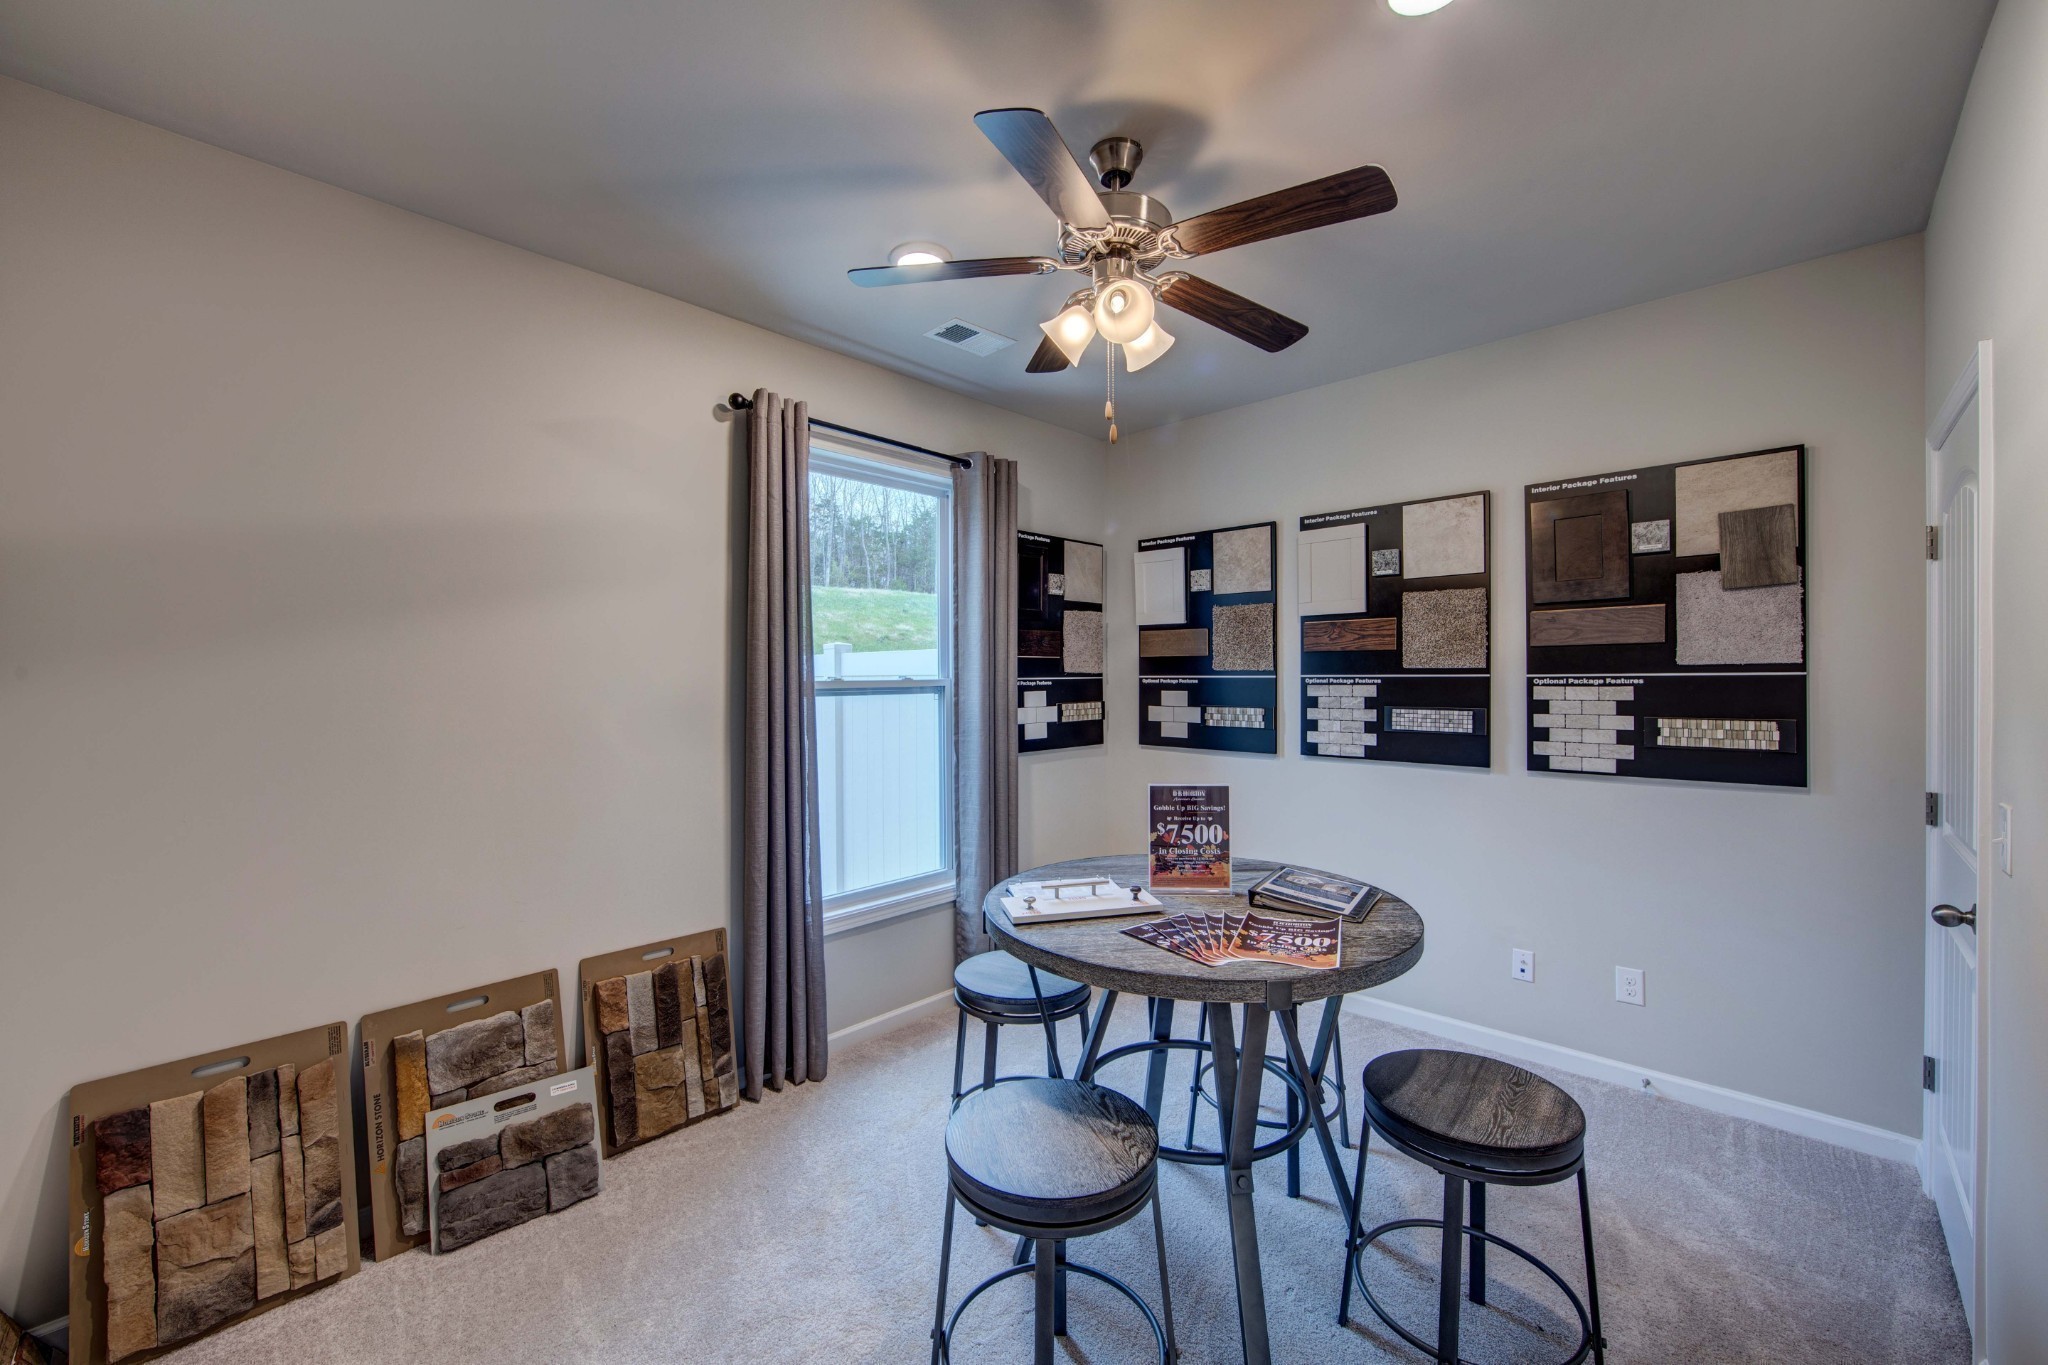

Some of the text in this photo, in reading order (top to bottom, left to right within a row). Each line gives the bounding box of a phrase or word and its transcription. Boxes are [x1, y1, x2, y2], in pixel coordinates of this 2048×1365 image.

[1531, 474, 1638, 494] Interior Package Features
[1351, 510, 1378, 518] Features
[1533, 677, 1644, 686] Optional Package Features
[1176, 804, 1186, 812] Up
[1200, 804, 1226, 812] Savings!
[1156, 822, 1223, 845] $7,500
[1158, 847, 1221, 856] in Closing Costs
[1259, 941, 1297, 951] Closing
[373, 1093, 385, 1162] HORIZON STONE
